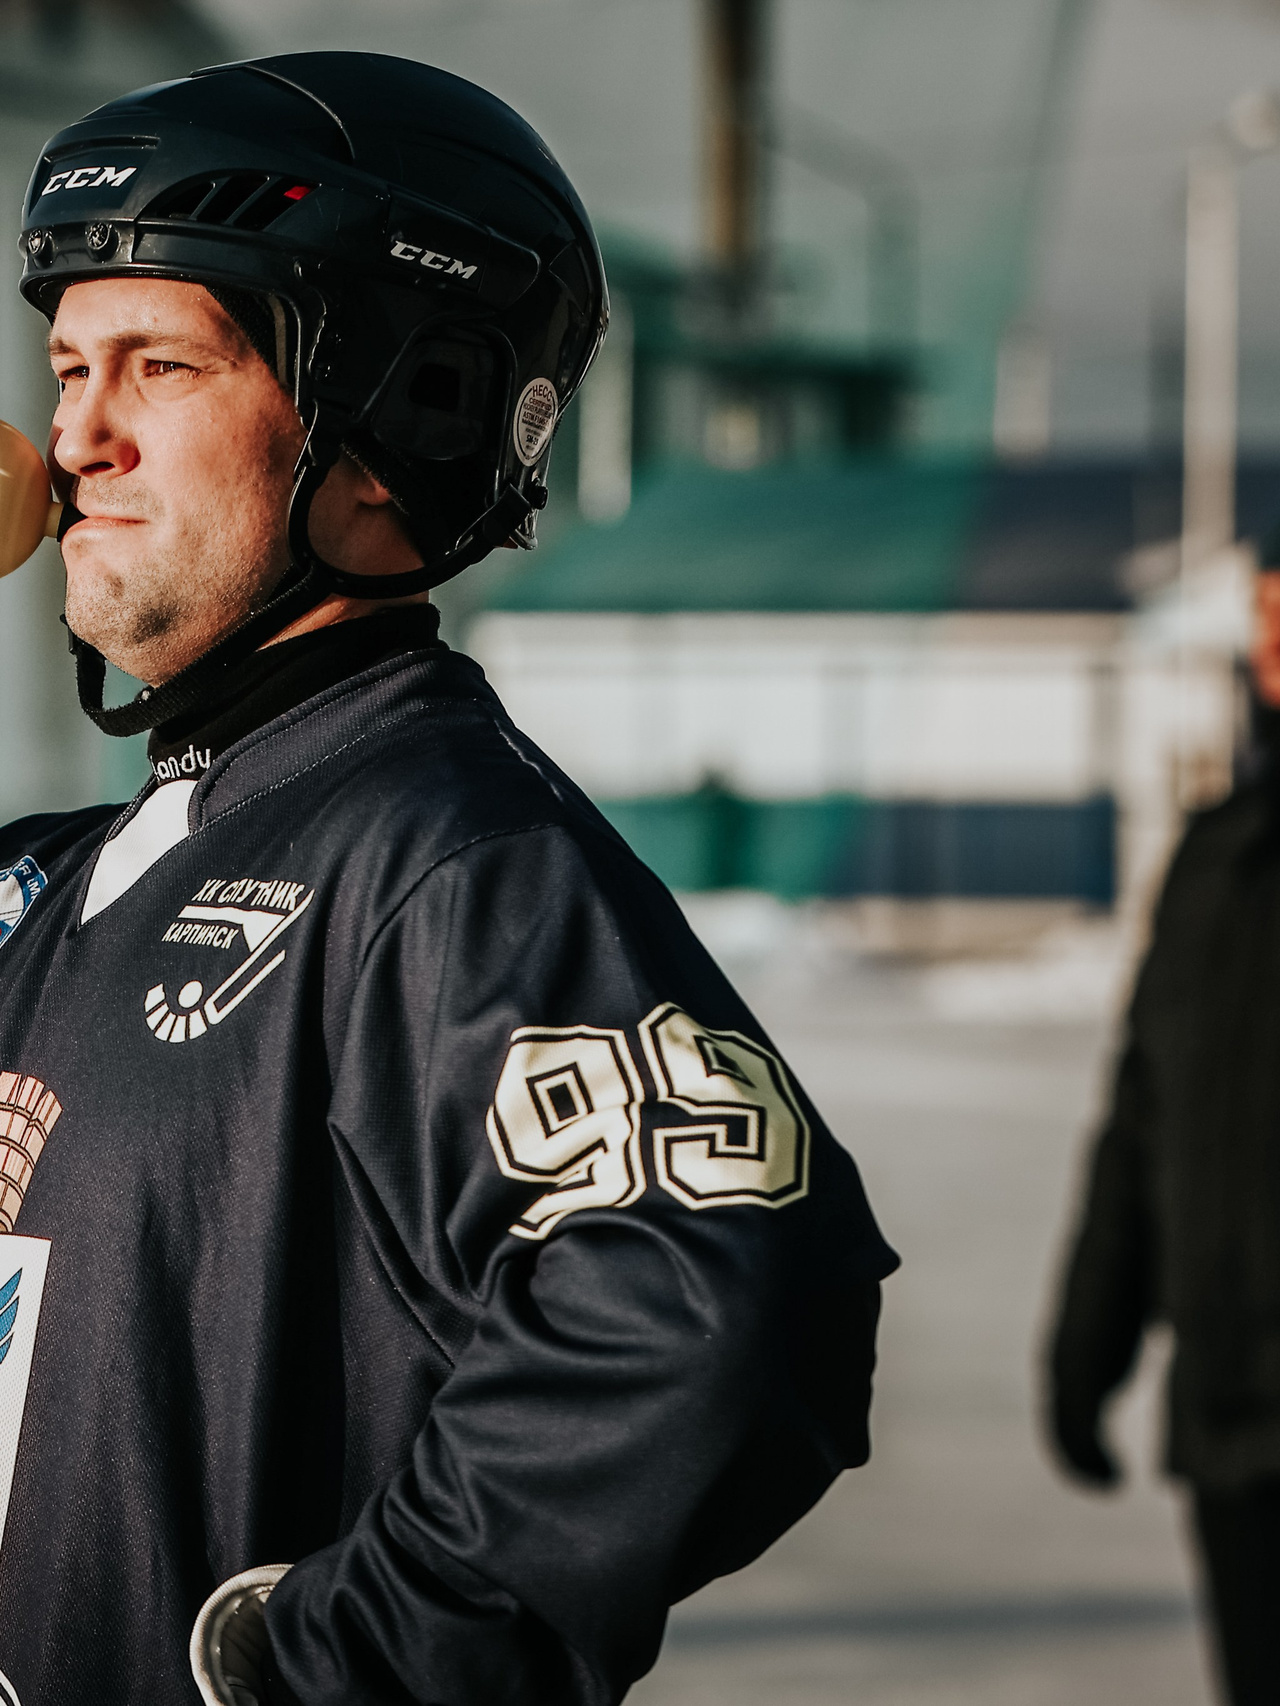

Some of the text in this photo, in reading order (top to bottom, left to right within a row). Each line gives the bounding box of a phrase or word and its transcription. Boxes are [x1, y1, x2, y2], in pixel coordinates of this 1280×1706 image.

[41, 166, 138, 197] CCM
[390, 240, 478, 280] CCM
[532, 384, 553, 402] HECC
[150, 744, 211, 781] andy
[191, 878, 306, 911] ХК СПУТНИК
[161, 922, 240, 949] КАРПИНСК
[484, 1001, 811, 1241] 99
